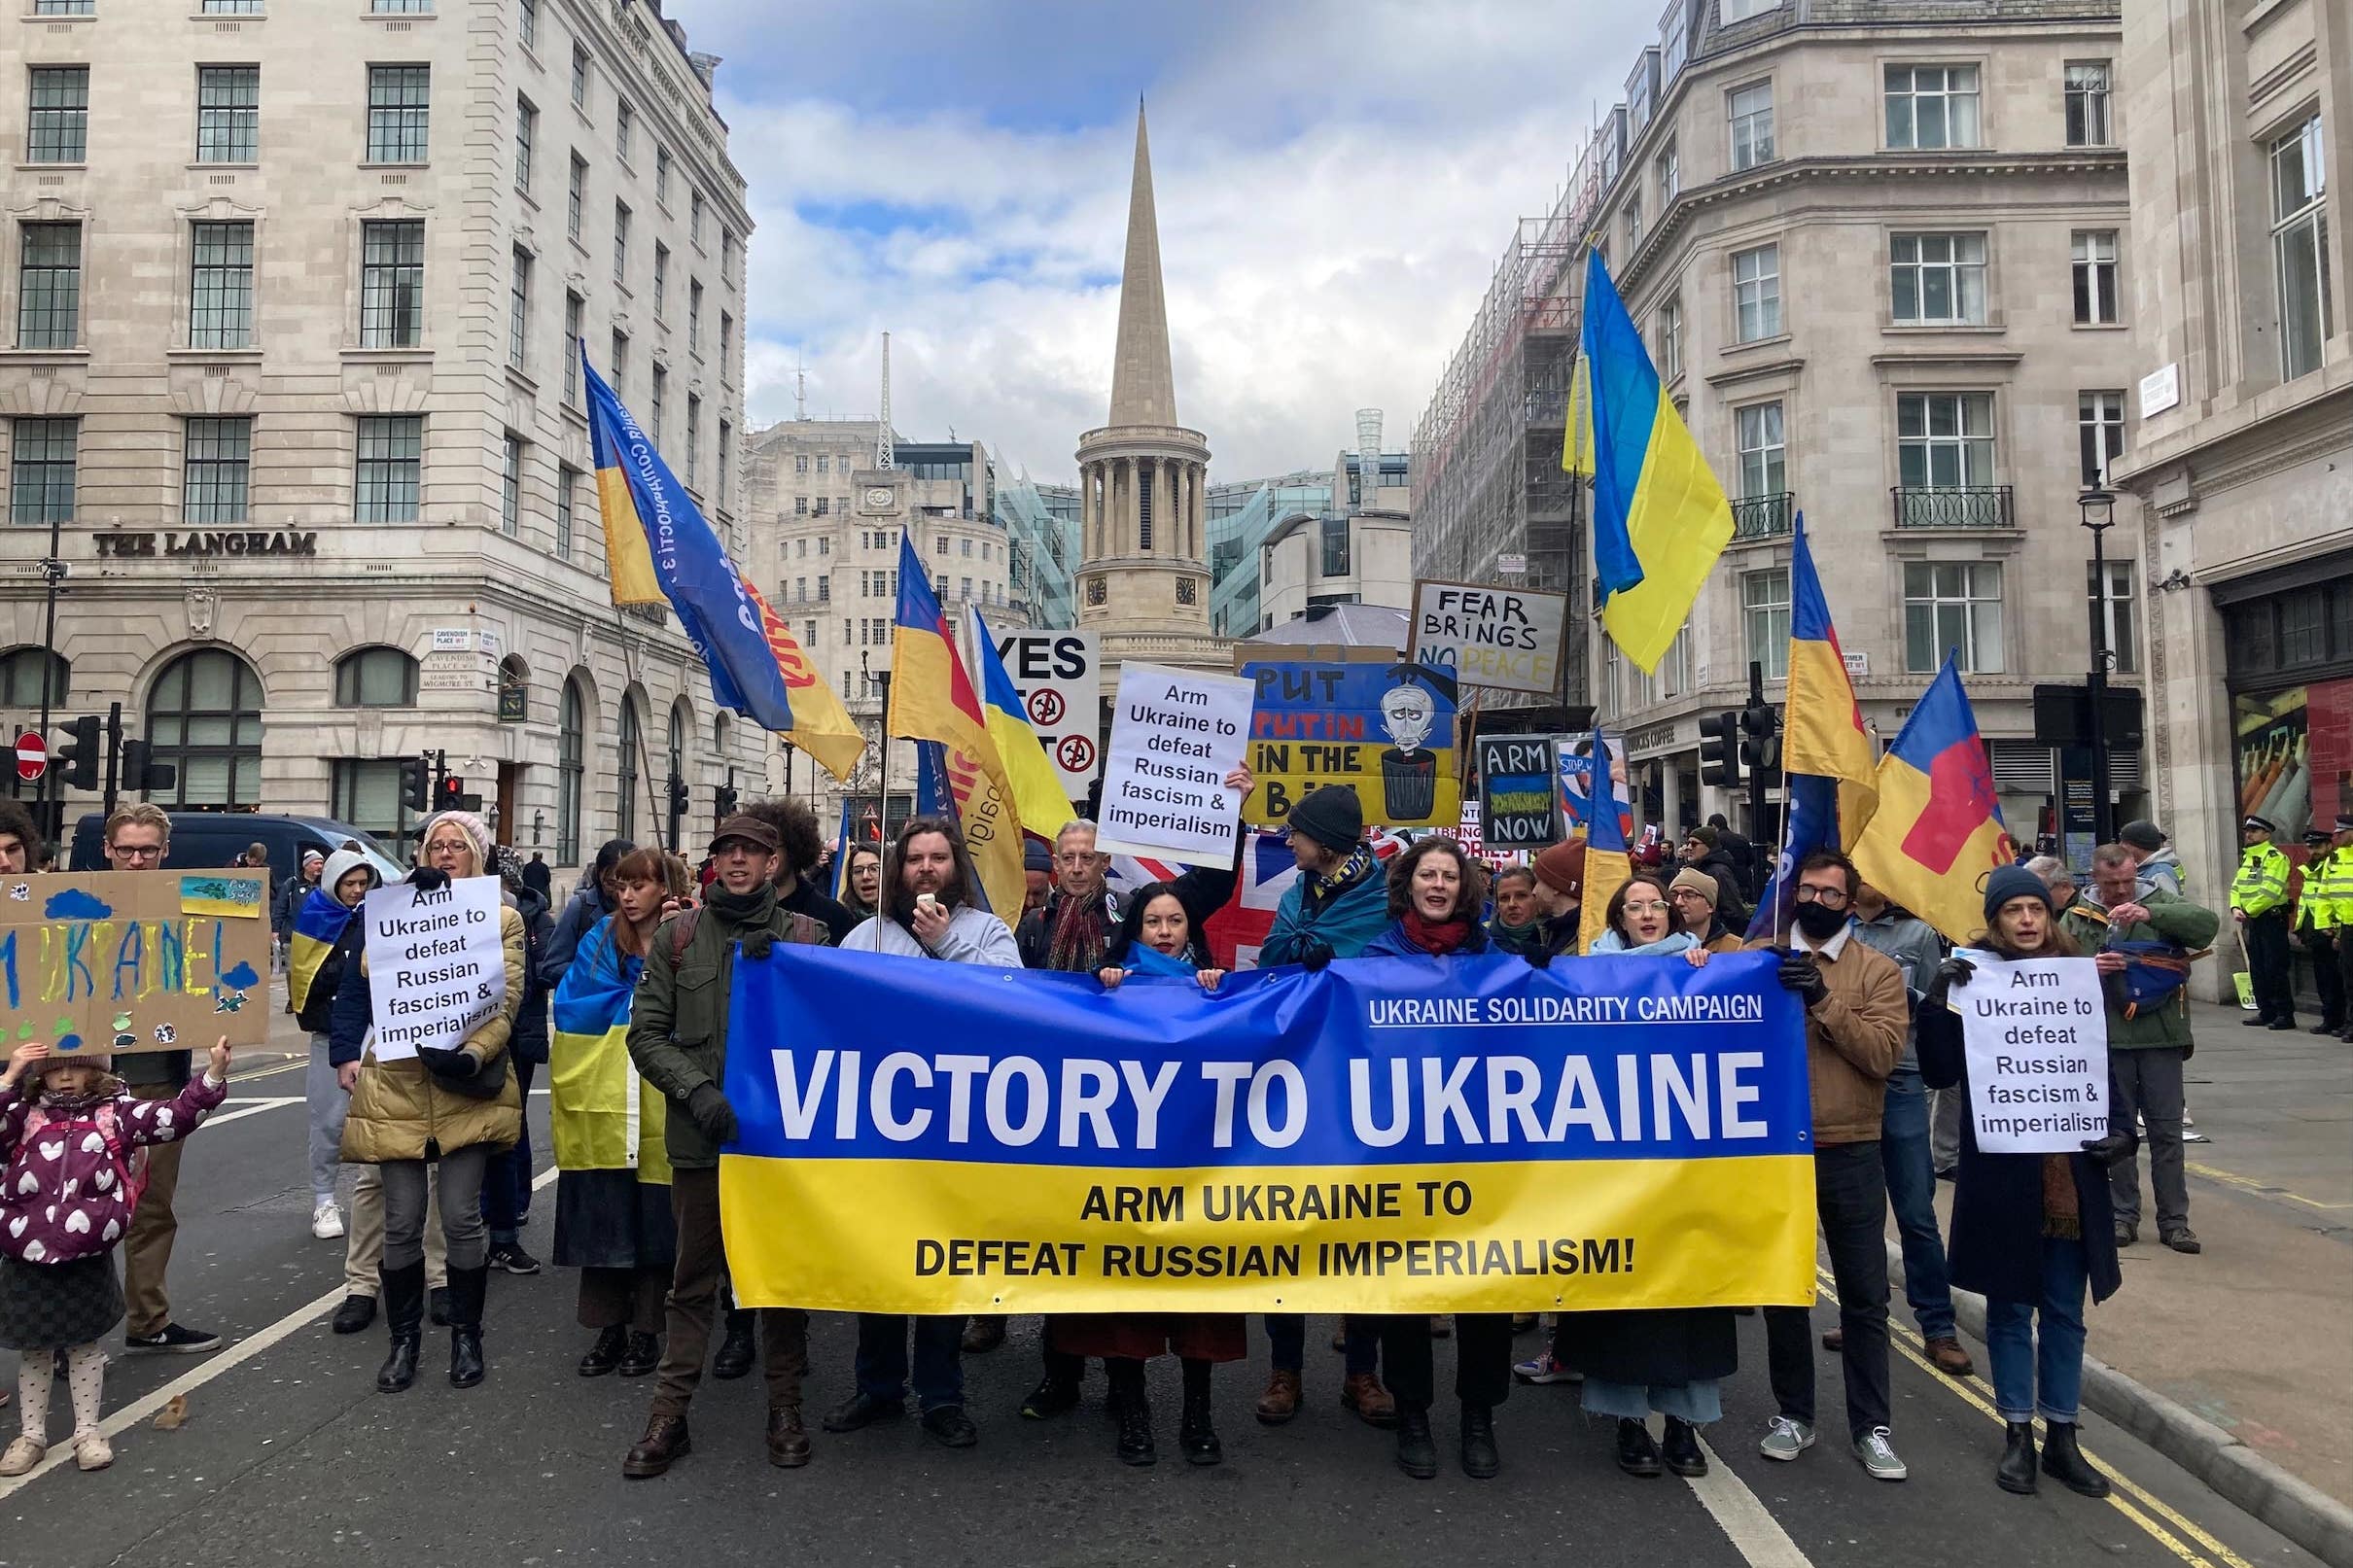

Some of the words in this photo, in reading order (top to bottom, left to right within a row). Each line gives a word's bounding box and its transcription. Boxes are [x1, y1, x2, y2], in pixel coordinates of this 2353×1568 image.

[93, 533, 156, 556] THE
[164, 533, 317, 556] LANGHAM
[1439, 591, 1528, 625] FEAR
[1419, 645, 1456, 665] NO
[1462, 646, 1552, 684] PEACE
[1164, 685, 1208, 706] Arm
[1255, 668, 1345, 702] PUT
[1131, 705, 1210, 732] Ukraine
[1216, 718, 1236, 736] to
[1147, 734, 1212, 758] defeat
[1300, 746, 1361, 772] THE
[1487, 744, 1548, 775] ARM
[1135, 757, 1218, 785] Russian
[1560, 759, 1583, 772] STOP
[1121, 781, 1203, 807] fascism
[1211, 793, 1225, 810] &
[1108, 804, 1231, 838] imperialism
[1493, 814, 1550, 841] NOW
[411, 889, 452, 908] Arm
[379, 914, 459, 937] Ukraine
[466, 908, 486, 923] to
[405, 935, 467, 960] defeat
[397, 962, 479, 988] Russian
[2011, 970, 2059, 989] Arm
[389, 991, 470, 1016] fascism
[477, 983, 492, 999] &
[1369, 998, 1479, 1026] UKRAINE
[1487, 996, 1630, 1024] SOLIDARITY
[1638, 993, 1763, 1022] CAMPAIGN
[1976, 996, 2068, 1017] Ukraine
[2074, 997, 2092, 1015] to
[381, 1002, 499, 1043] imperialism
[2004, 1026, 2077, 1045] defeat
[1996, 1055, 2088, 1074] Russian
[770, 1048, 1182, 1150] VICTORY
[1201, 1060, 1308, 1149] TO
[1350, 1052, 1769, 1148] UKRAINE
[1987, 1084, 2080, 1103] fascism
[2086, 1083, 2098, 1102] &
[1981, 1113, 2108, 1136] imperialism
[1079, 1185, 1185, 1223] ARM
[1202, 1182, 1402, 1224] UKRAINE
[1417, 1179, 1473, 1217] TO
[915, 1239, 1086, 1278] DEFEAT
[1103, 1244, 1299, 1278] RUSSIAN
[1319, 1237, 1635, 1277] IMPERIALISM!
